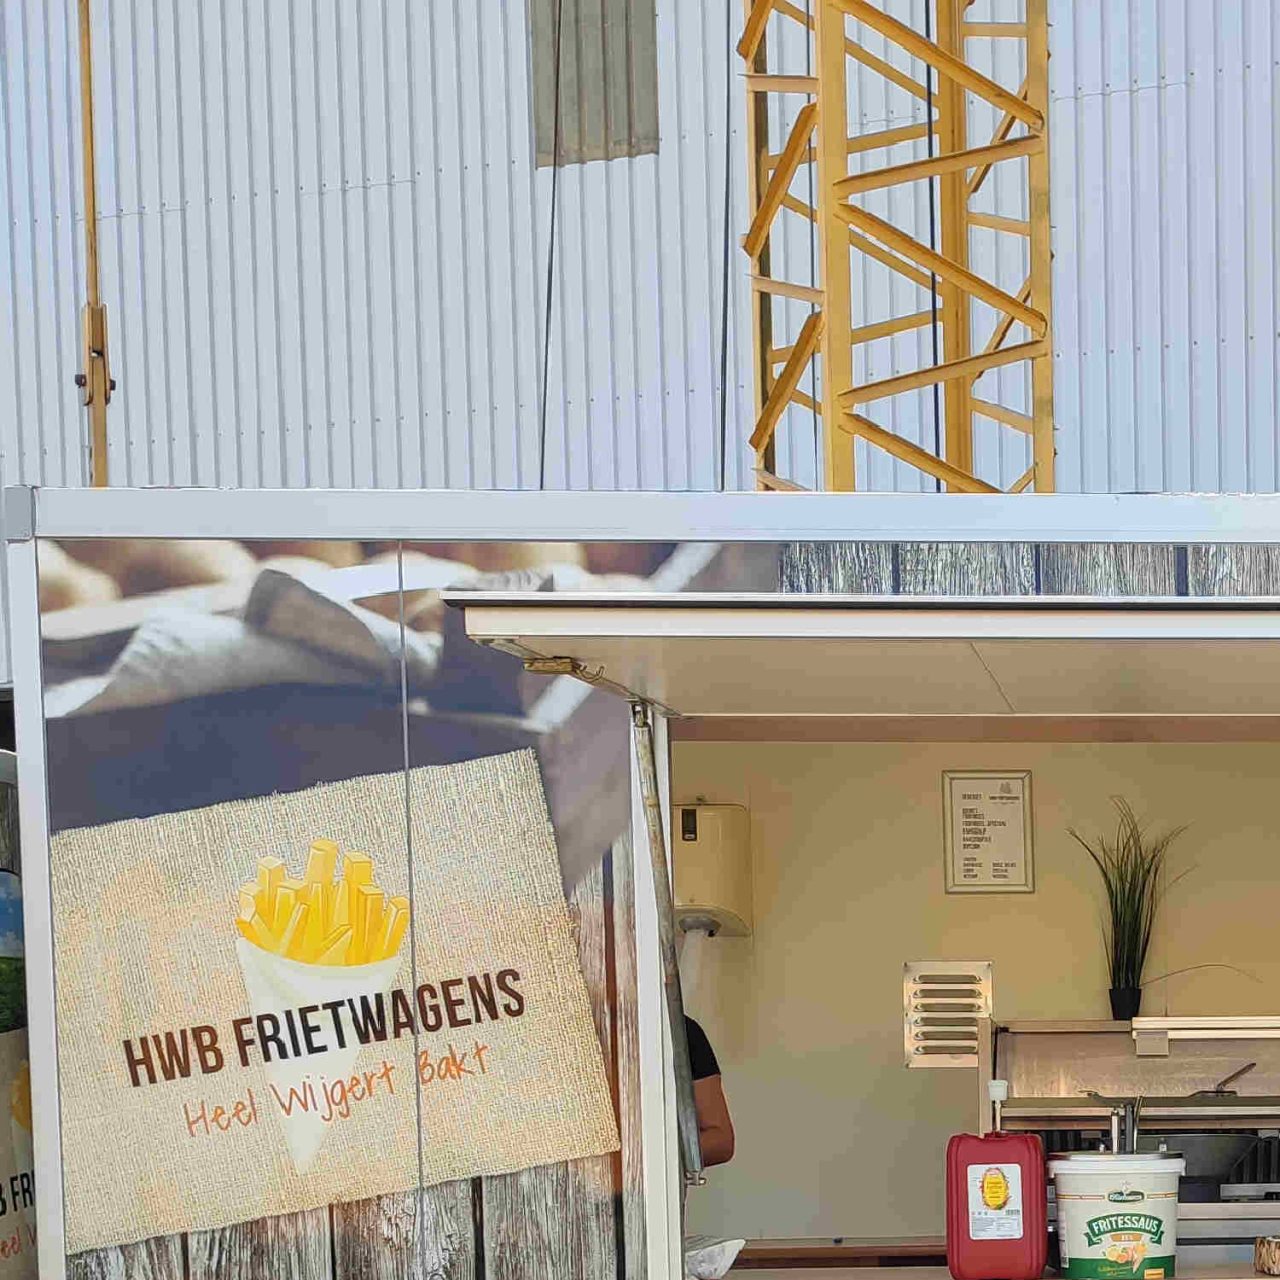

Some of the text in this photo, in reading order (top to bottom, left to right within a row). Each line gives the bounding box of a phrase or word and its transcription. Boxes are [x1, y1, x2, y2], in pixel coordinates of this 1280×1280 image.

[122, 968, 525, 1087] HWB FRIETWAGENS
[183, 1038, 490, 1138] Heel Wijgert Bakt
[9, 1168, 35, 1213] FR
[1092, 1215, 1159, 1234] FRITESSAUS
